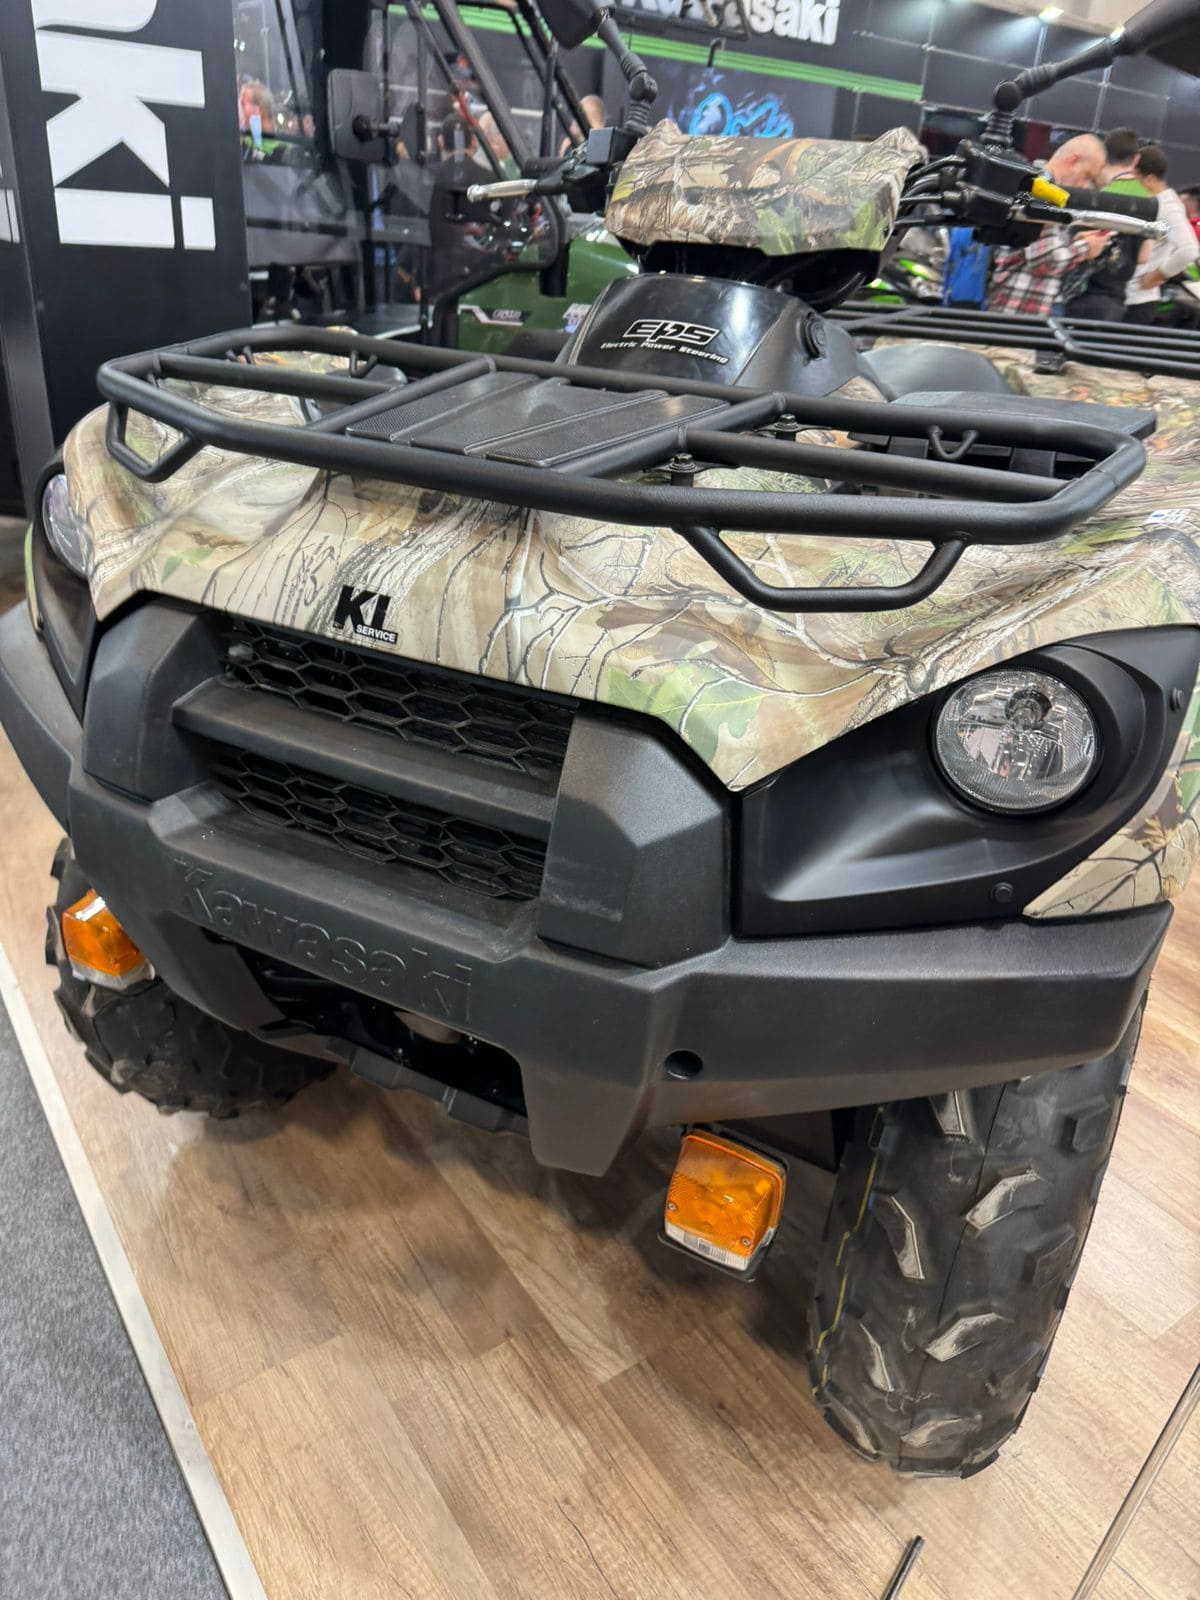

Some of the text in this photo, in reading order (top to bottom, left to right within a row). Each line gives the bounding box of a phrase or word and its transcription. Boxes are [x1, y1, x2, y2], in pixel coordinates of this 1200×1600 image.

[31, 0, 216, 250] ki
[623, 319, 720, 345] EPS
[600, 341, 729, 364] Electric Power Steering
[333, 585, 391, 633] KI
[356, 624, 396, 642] SERVICE
[174, 857, 473, 1021] Kawasaki
